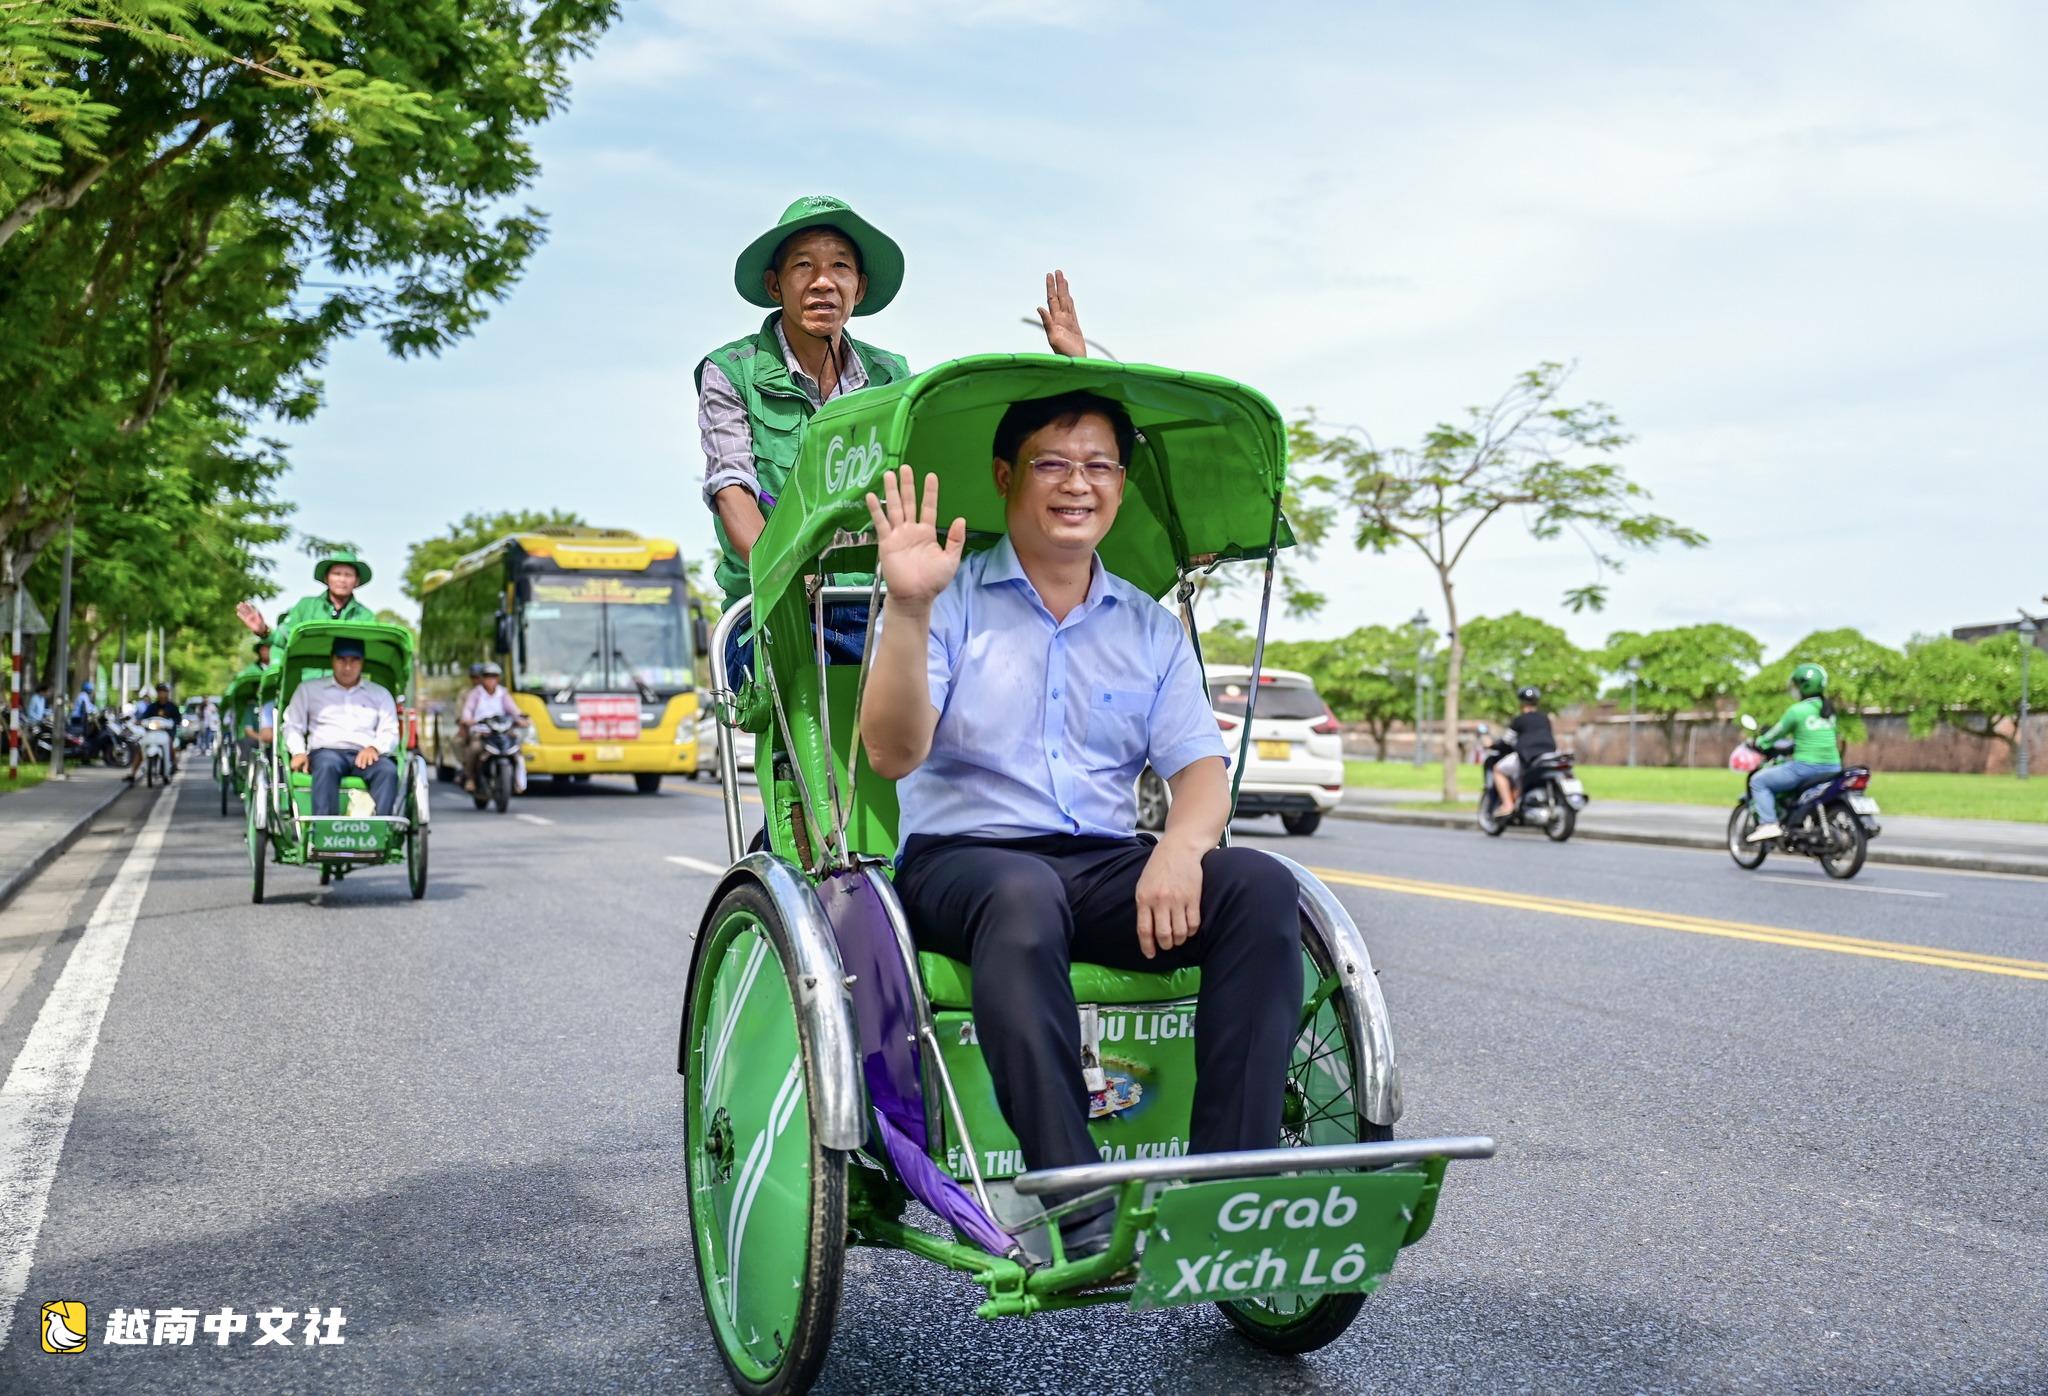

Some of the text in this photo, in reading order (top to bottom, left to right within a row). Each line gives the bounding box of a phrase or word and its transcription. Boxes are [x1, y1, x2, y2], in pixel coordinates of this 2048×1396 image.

[825, 425, 883, 495] Grab
[323, 834, 377, 848] Xích Lô
[332, 820, 370, 833] Grab
[1134, 1013, 1196, 1046] LỊCH
[984, 1149, 1027, 1176] THU
[1098, 1139, 1127, 1162] ÒA
[1217, 1186, 1358, 1233] Grab
[1165, 1243, 1366, 1299] Xích Lô
